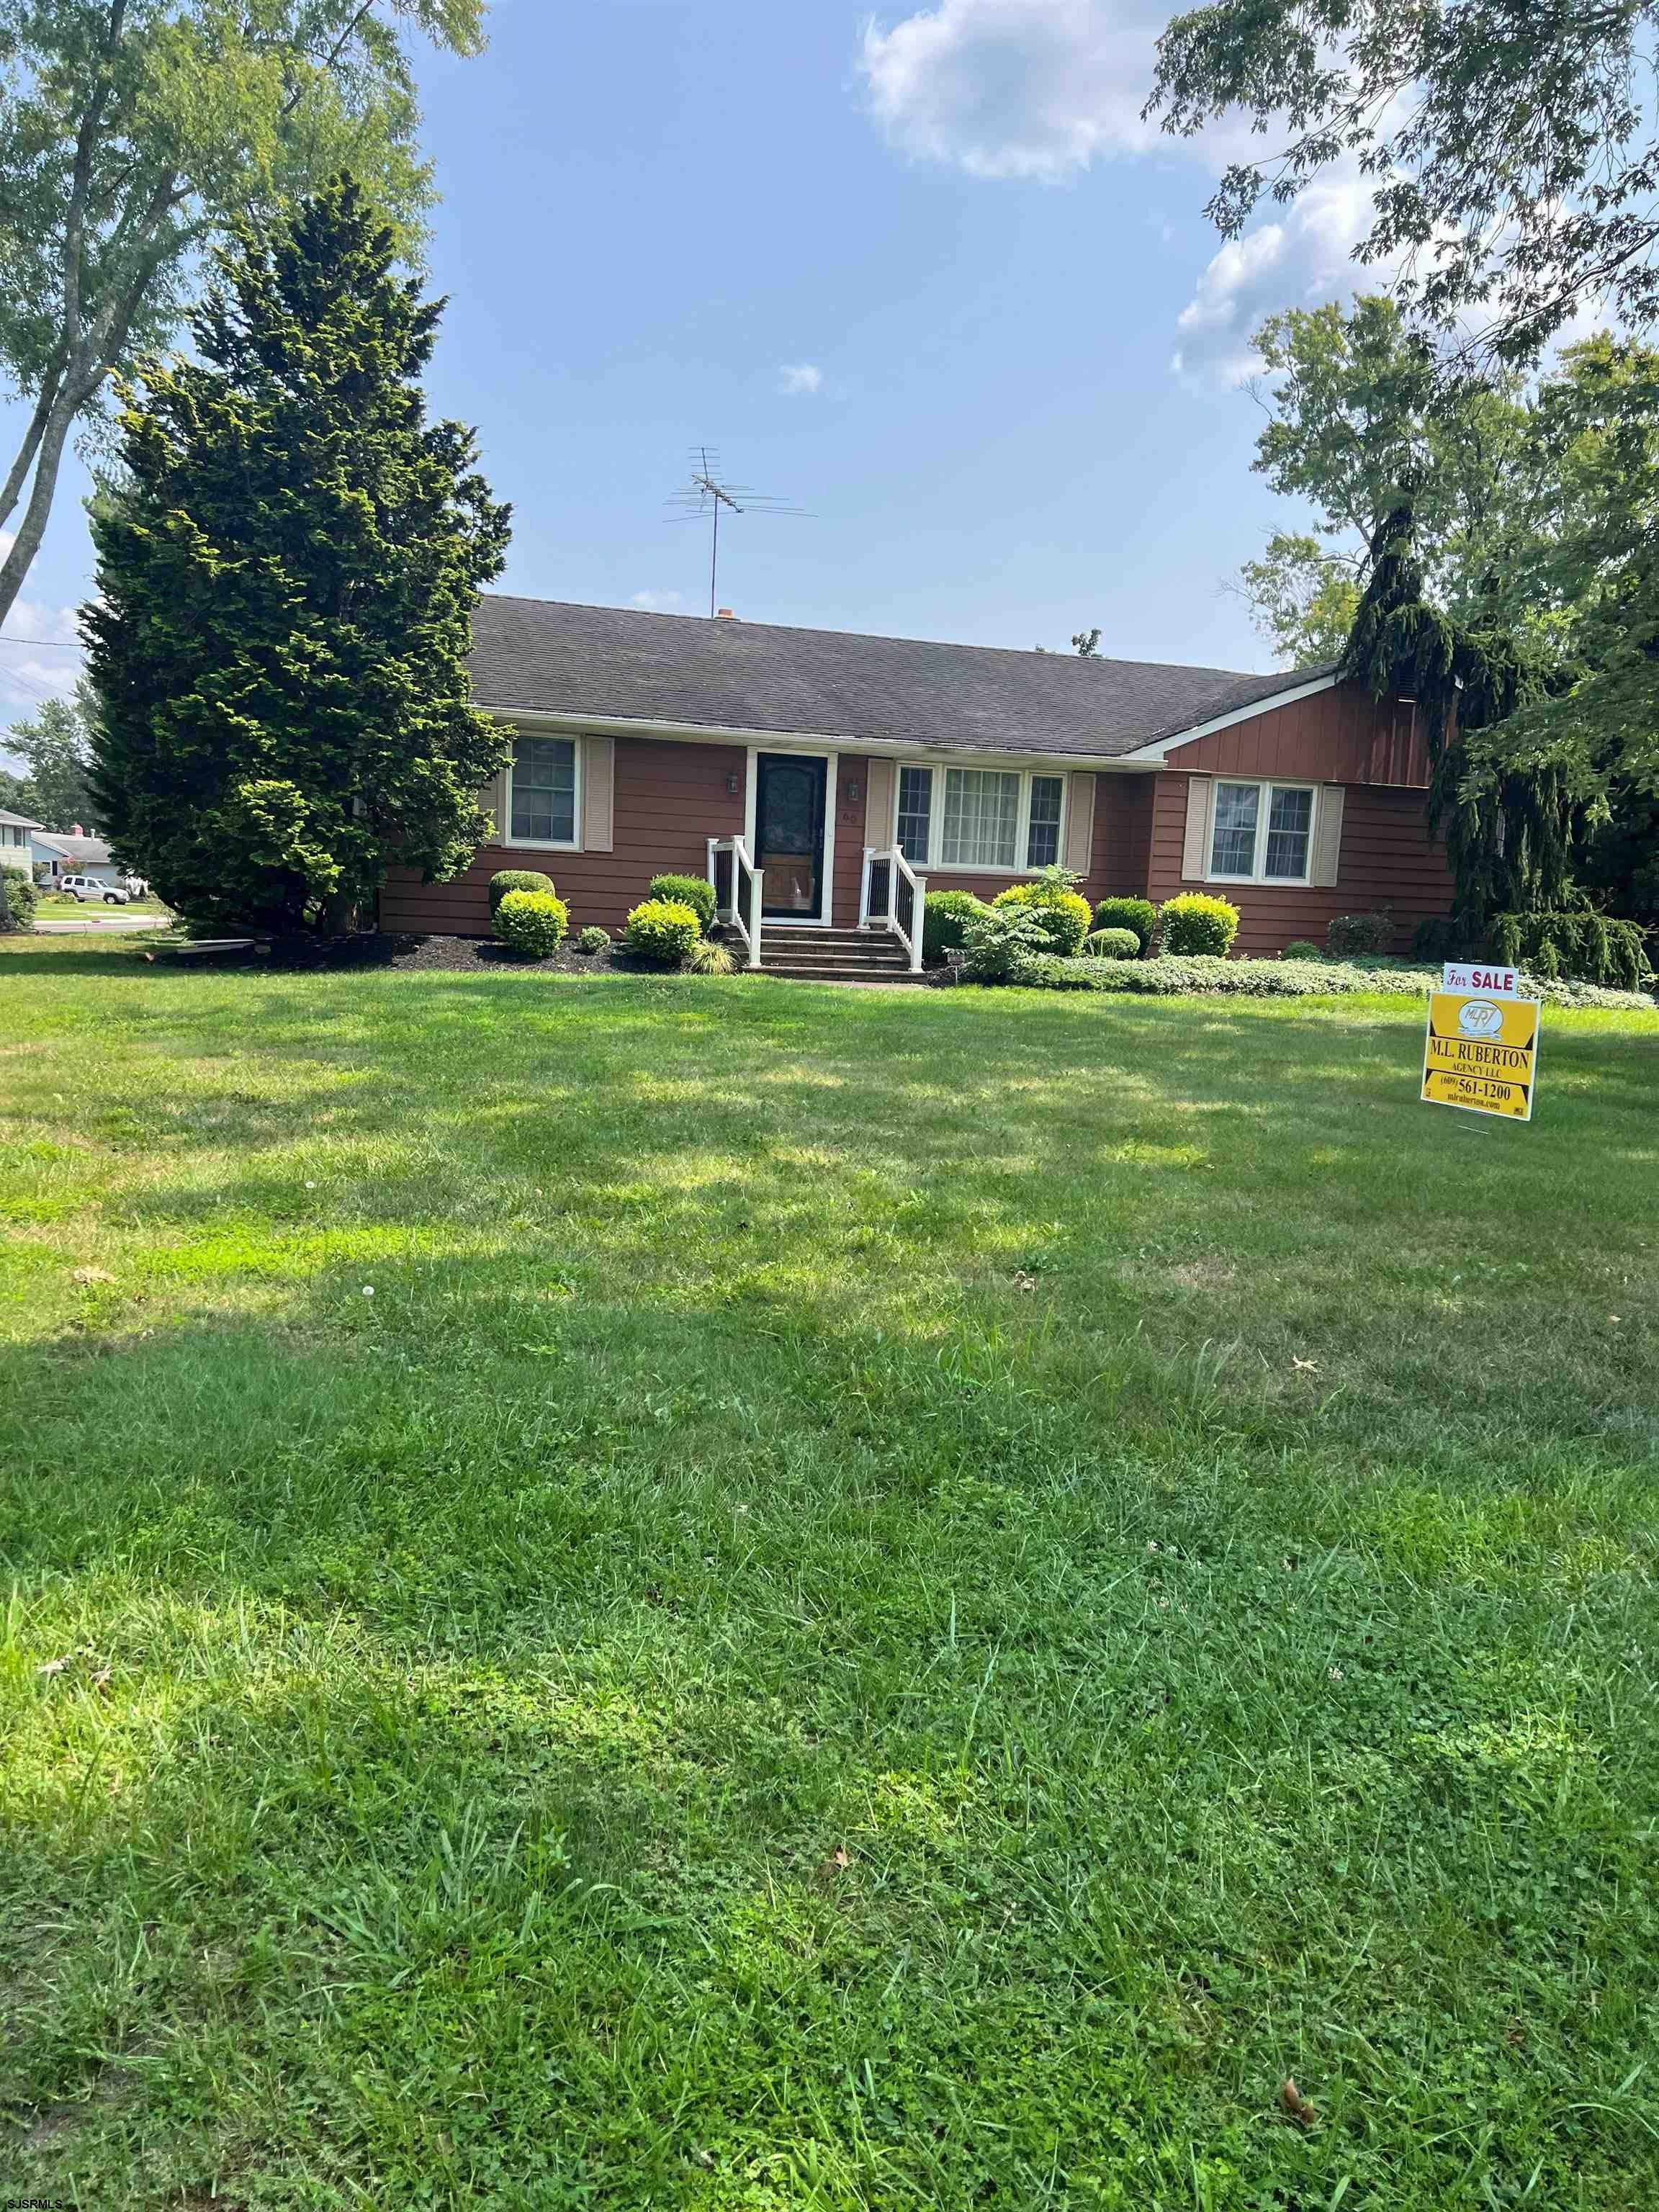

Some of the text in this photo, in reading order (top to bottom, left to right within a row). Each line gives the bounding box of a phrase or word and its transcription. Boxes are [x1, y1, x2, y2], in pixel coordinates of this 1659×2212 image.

[1447, 970, 1514, 992] For SALE
[1430, 1039, 1531, 1070] M.L. RUBERTON
[1452, 1064, 1502, 1079] AGENCY LLC
[1447, 1092, 1501, 1110] mlruberton.com
[1458, 1079, 1511, 1101] 561-1200
